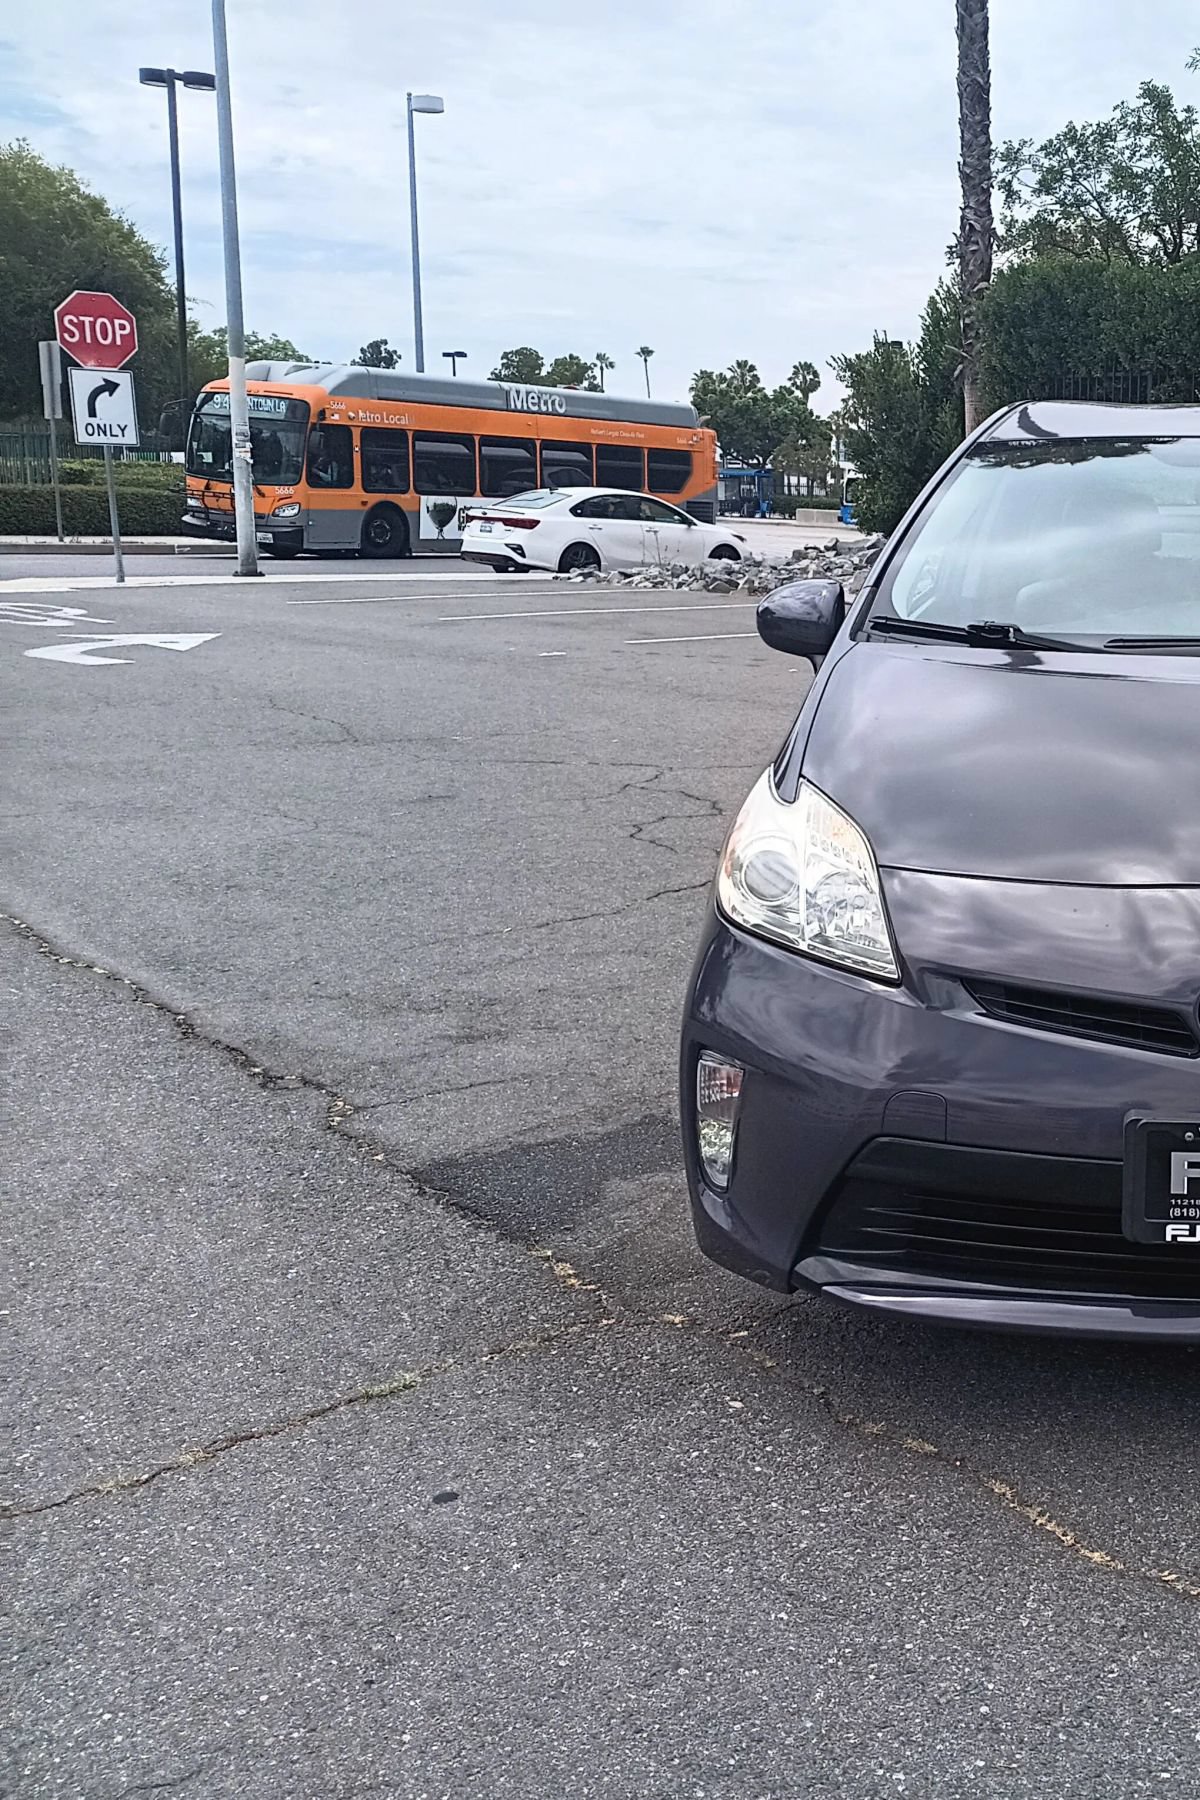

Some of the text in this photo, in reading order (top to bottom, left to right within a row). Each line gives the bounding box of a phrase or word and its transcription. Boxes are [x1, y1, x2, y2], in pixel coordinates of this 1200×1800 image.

[62, 314, 131, 346] STOP
[276, 399, 286, 412] LA
[510, 390, 567, 414] Metro
[384, 412, 409, 424] Local
[84, 422, 128, 438] ONLY
[1170, 1208, 1200, 1219] (818)
